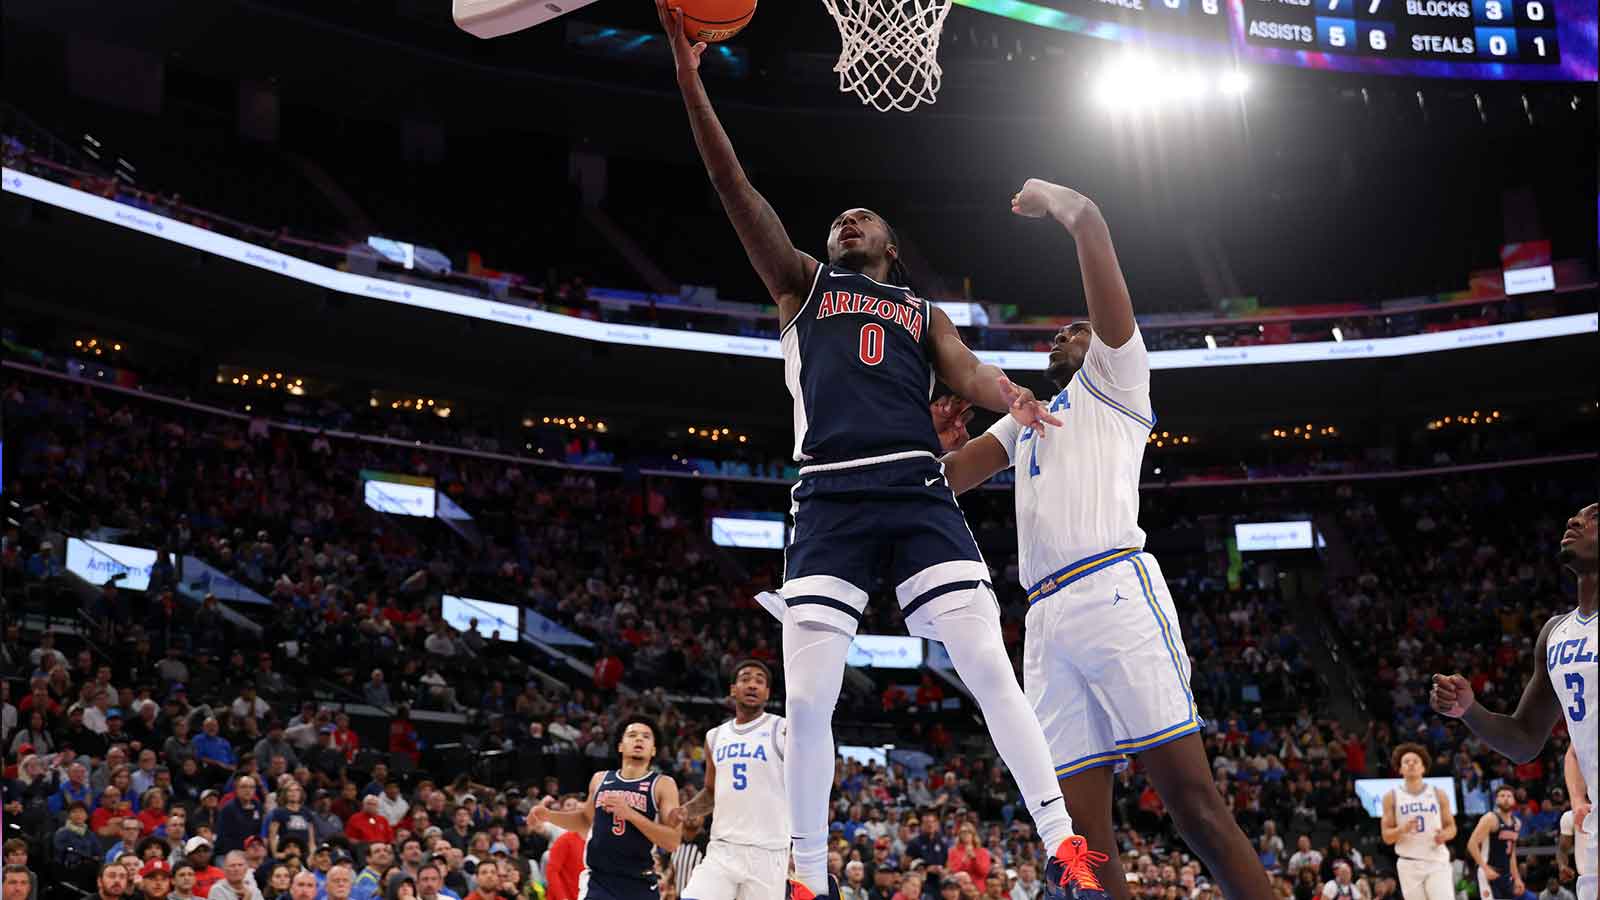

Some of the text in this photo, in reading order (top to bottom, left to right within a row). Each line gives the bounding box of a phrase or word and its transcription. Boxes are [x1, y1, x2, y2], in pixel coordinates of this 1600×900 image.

[1406, 0, 1545, 21] BLOCKS 3 0
[1249, 20, 1387, 50] ASSISTS 5 6
[1411, 34, 1546, 56] STEALS 0 1
[816, 291, 923, 343] ARIZONA
[858, 323, 885, 366] 0
[1548, 637, 1598, 672] UCL
[1564, 672, 1586, 722] 3
[716, 742, 768, 762] UCLA
[732, 763, 748, 790] 5
[1400, 802, 1438, 815] UCLA
